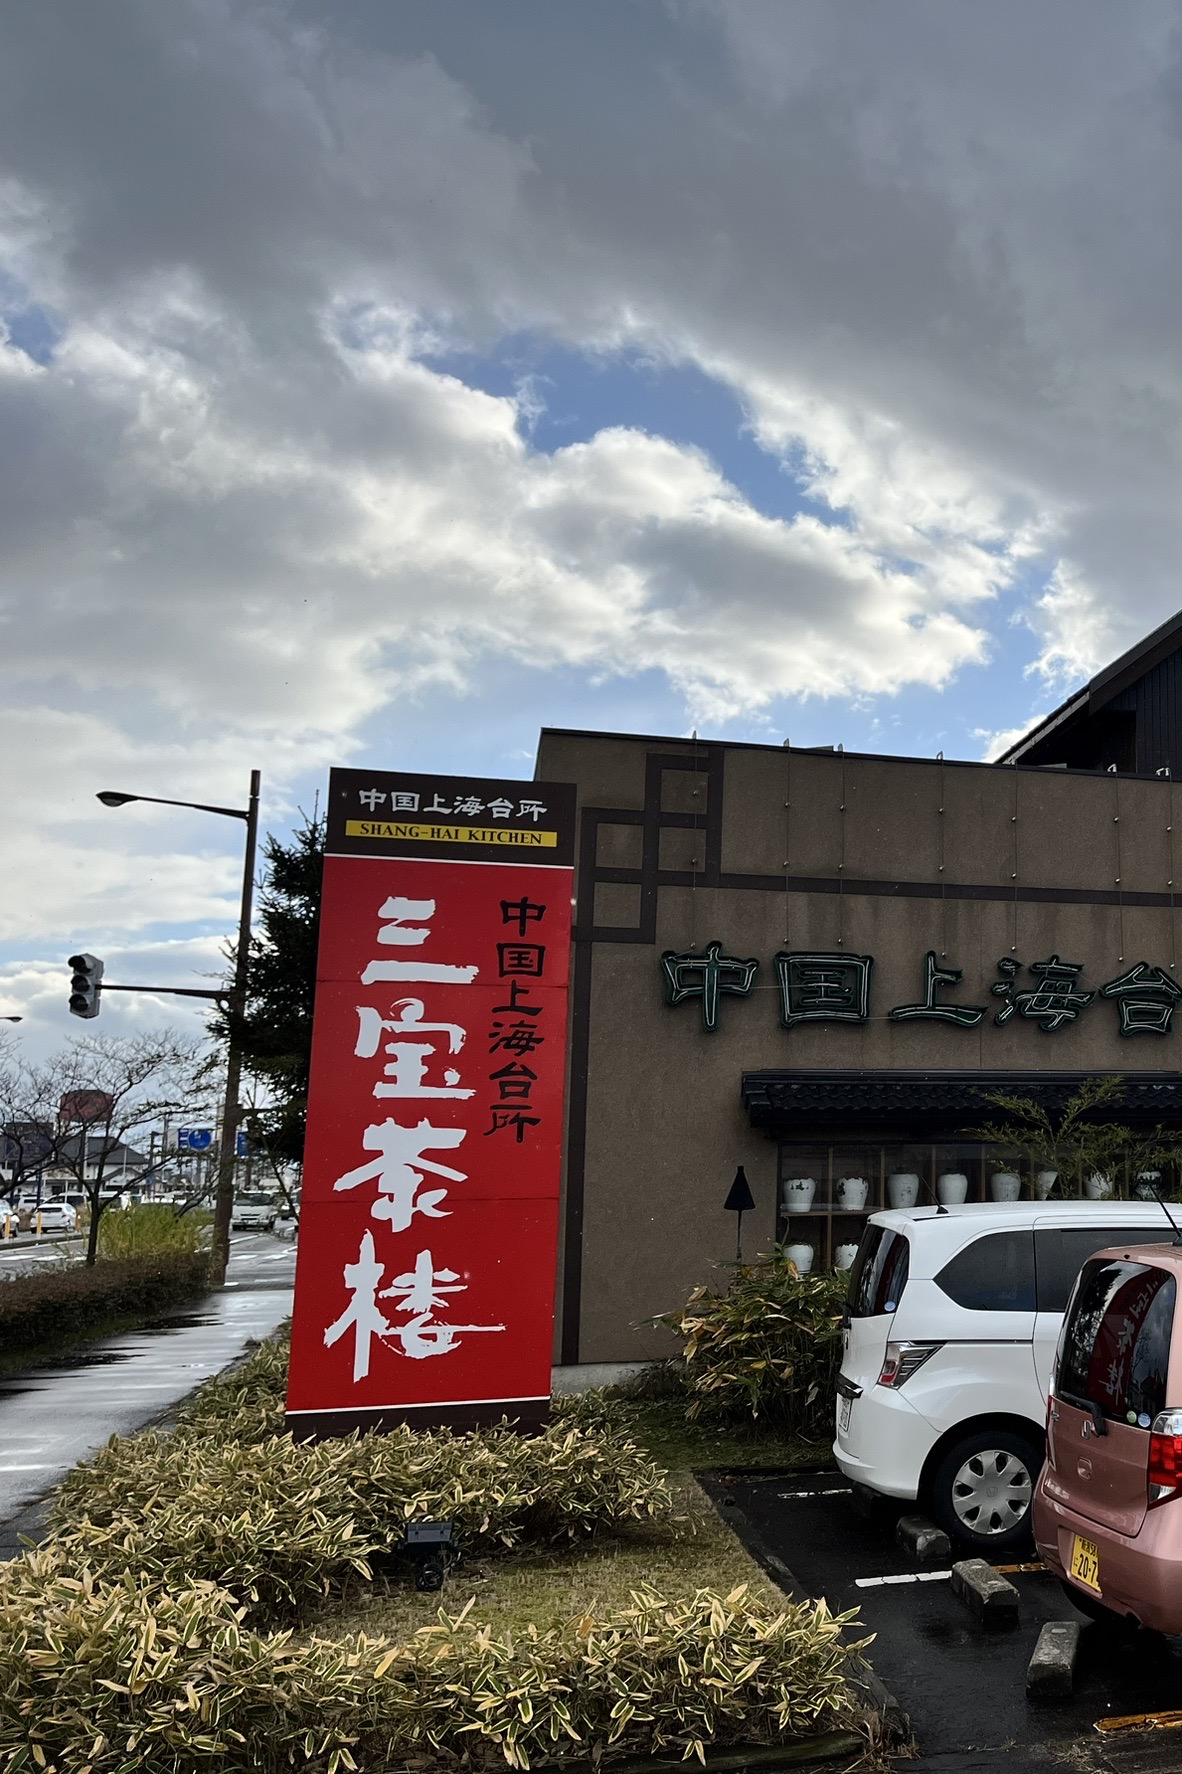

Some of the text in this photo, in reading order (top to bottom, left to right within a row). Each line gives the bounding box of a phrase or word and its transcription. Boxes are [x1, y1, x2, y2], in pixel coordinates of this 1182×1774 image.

[358, 788, 548, 822] 中国上海台所
[359, 823, 543, 845] SHANG-HAI KITCHEN
[482, 896, 547, 1143] 中国上海台所
[322, 895, 507, 1384] 三宝茶楼
[1077, 1553, 1098, 1584] 20-7
